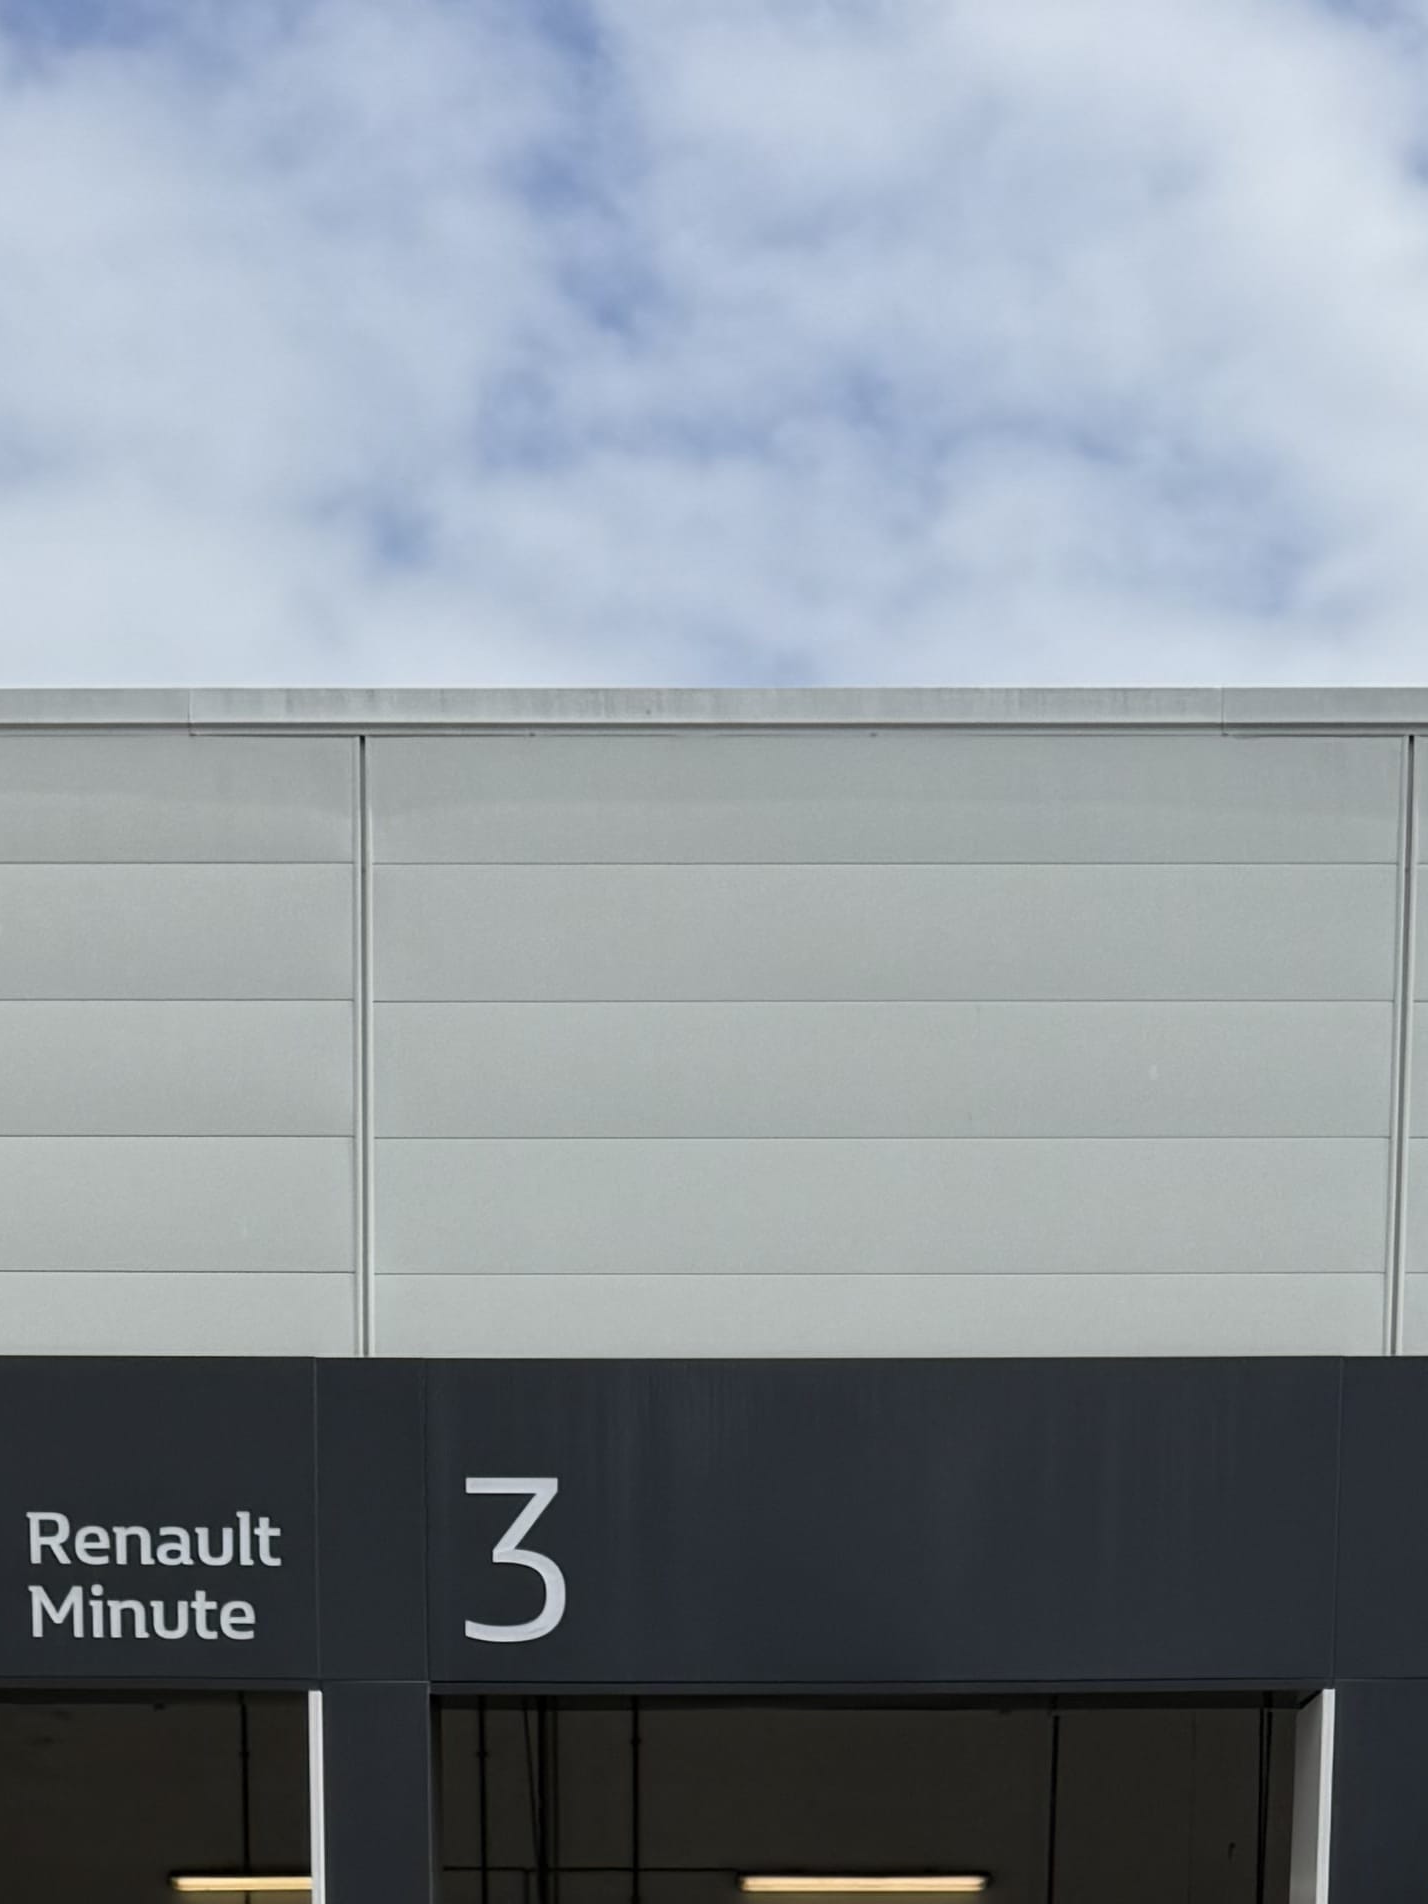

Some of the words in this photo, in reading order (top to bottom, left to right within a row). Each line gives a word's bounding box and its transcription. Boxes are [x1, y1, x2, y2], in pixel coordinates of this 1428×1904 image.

[27, 1512, 283, 1568] Renault
[465, 1478, 567, 1644] 3
[29, 1584, 257, 1641] Minute
